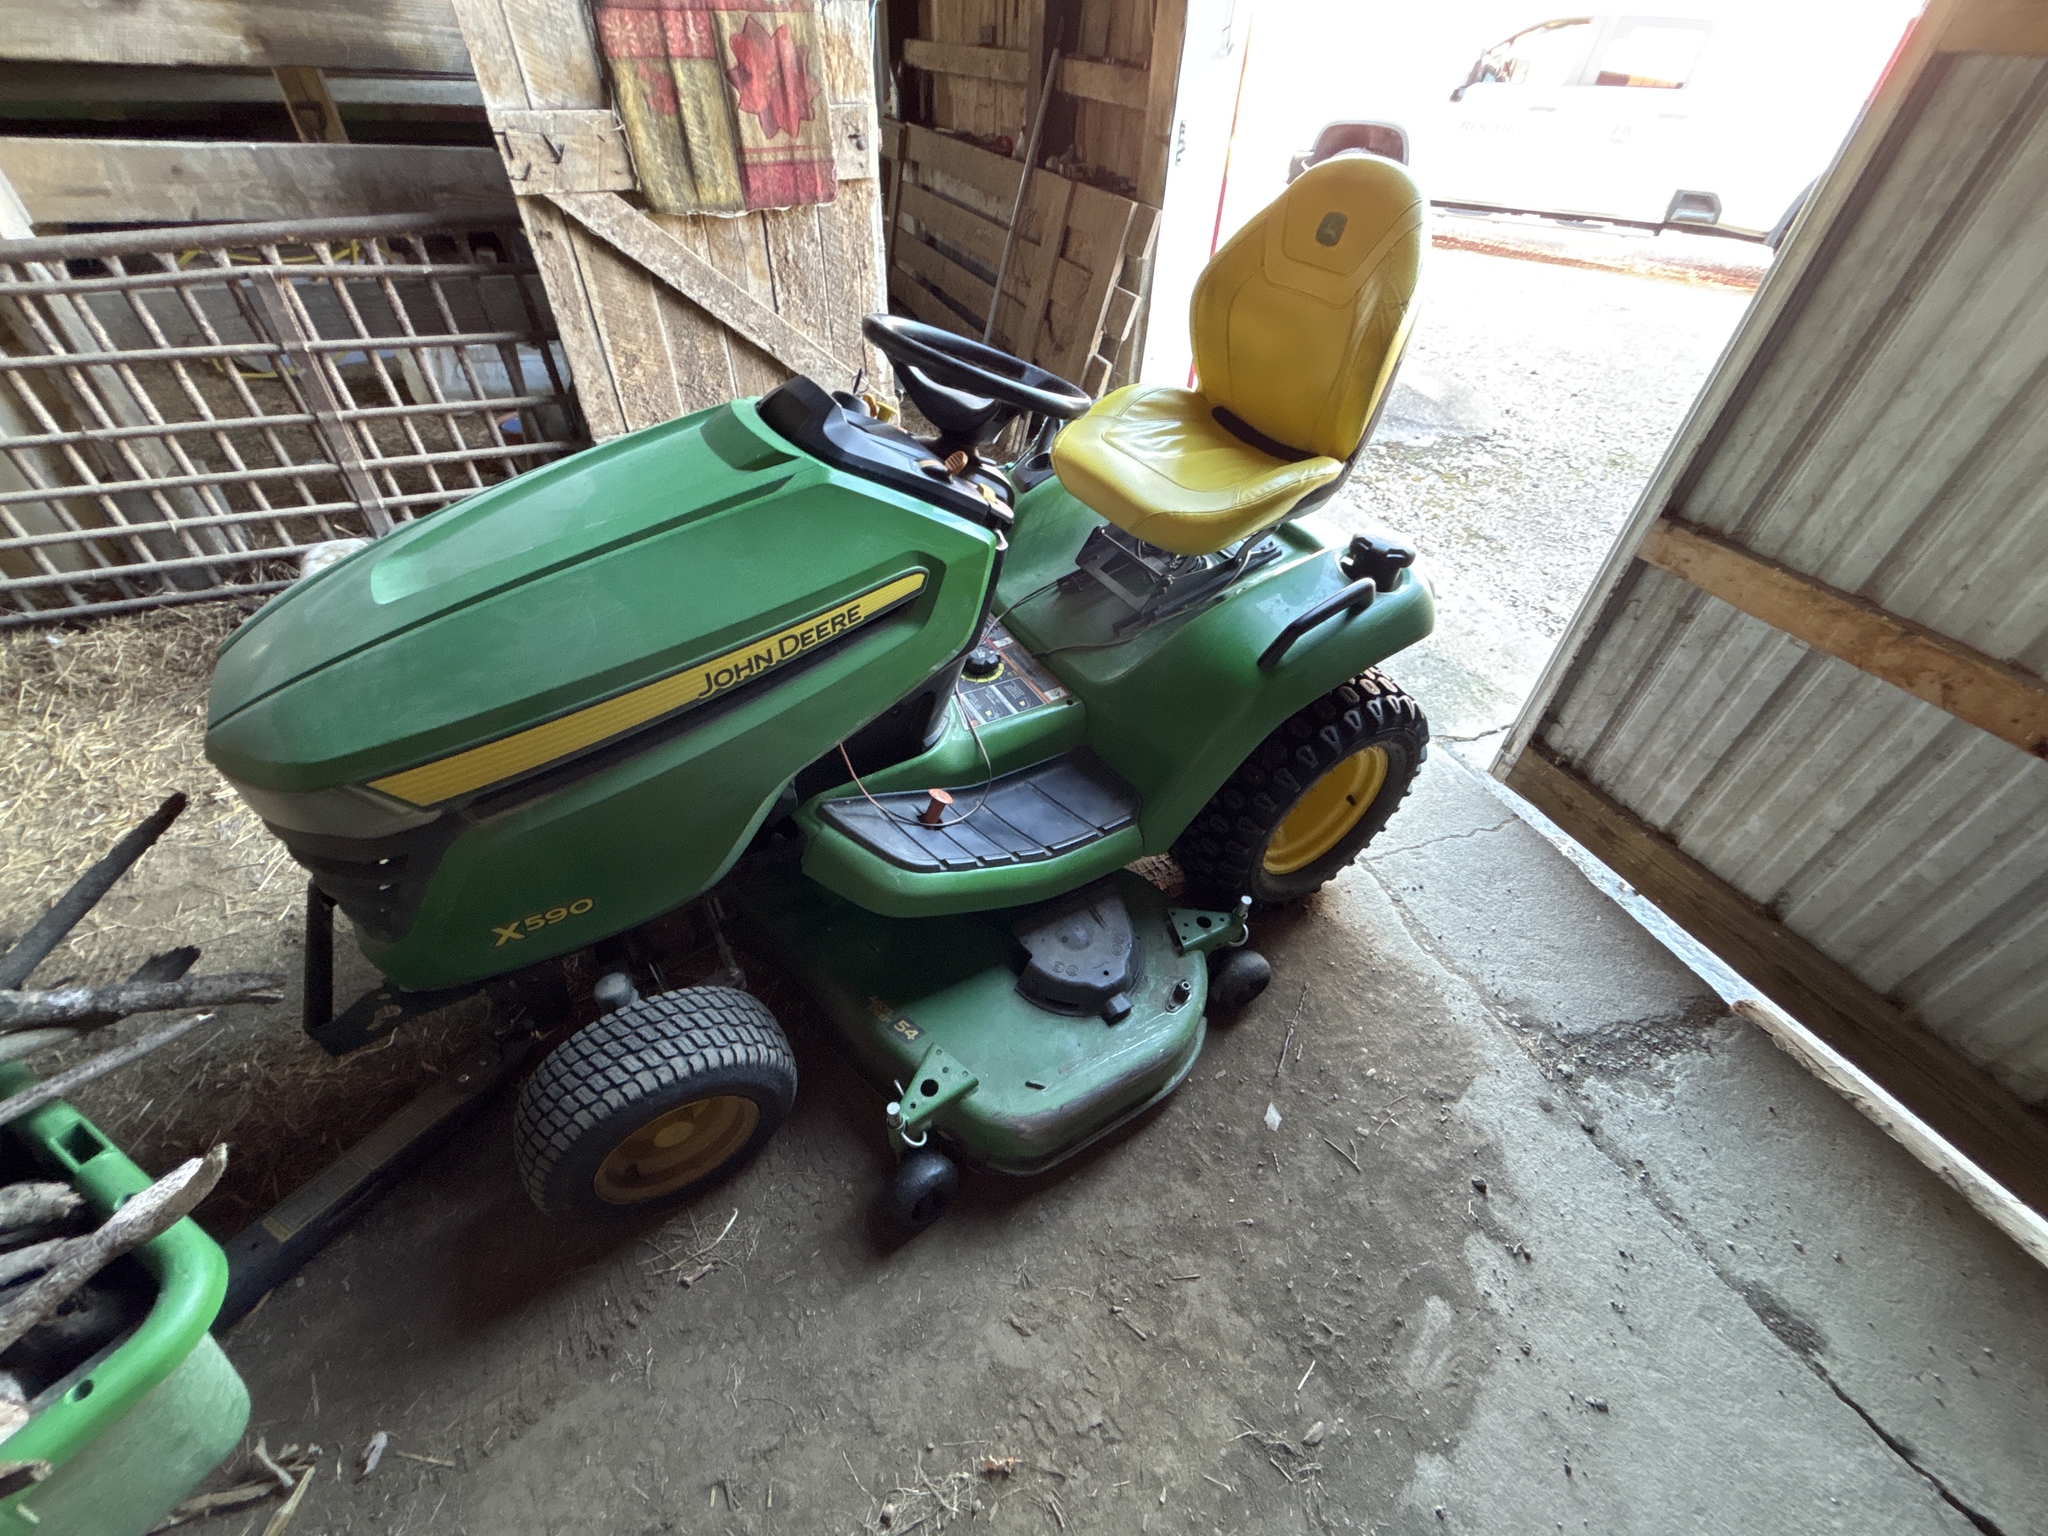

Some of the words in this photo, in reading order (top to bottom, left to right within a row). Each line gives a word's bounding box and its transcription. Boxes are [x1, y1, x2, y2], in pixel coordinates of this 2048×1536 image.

[698, 647, 774, 698] JOHN
[779, 604, 863, 658] DEERE
[491, 898, 594, 947] X590
[893, 1019, 919, 1041] 54
